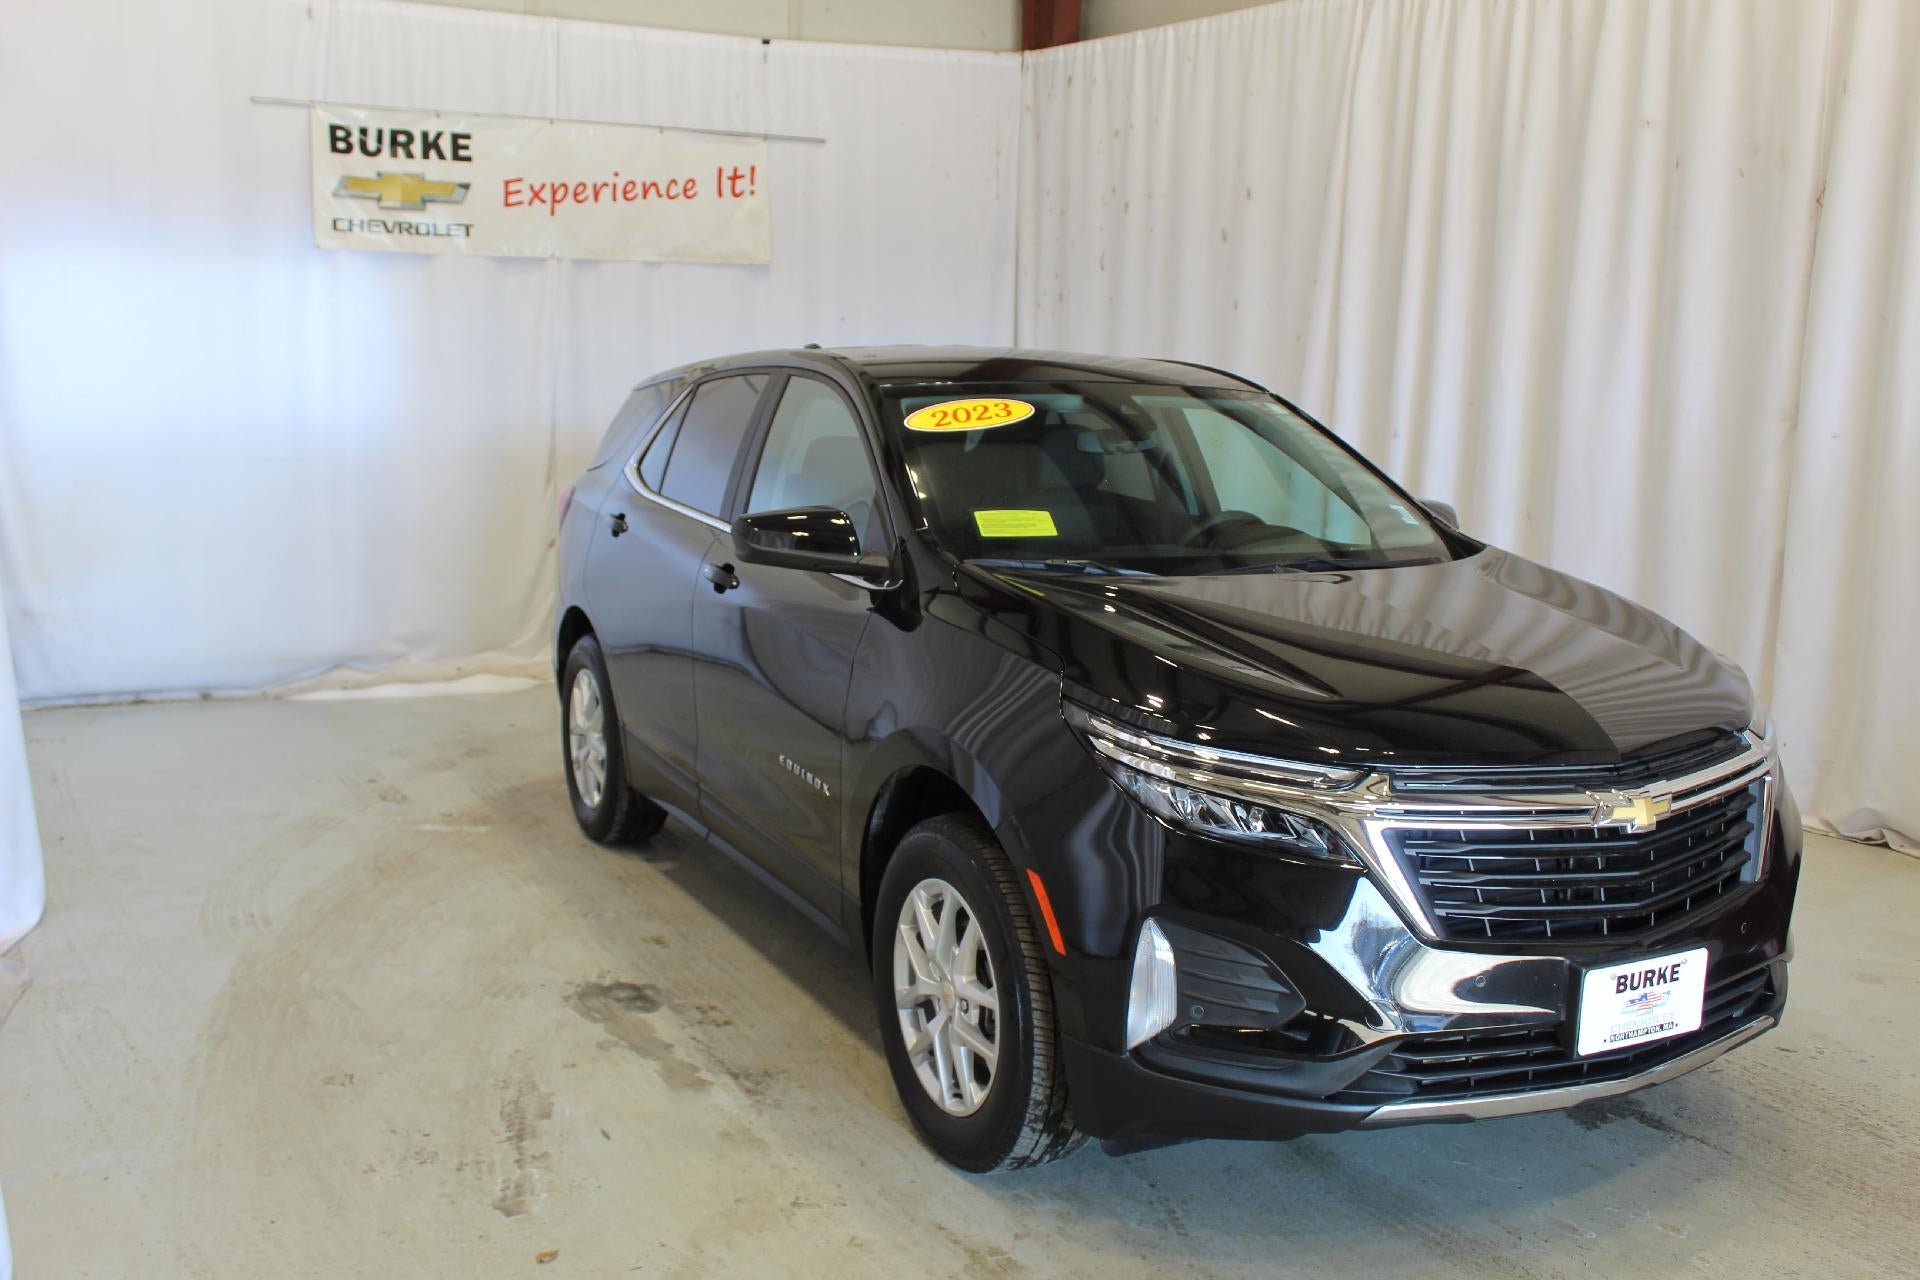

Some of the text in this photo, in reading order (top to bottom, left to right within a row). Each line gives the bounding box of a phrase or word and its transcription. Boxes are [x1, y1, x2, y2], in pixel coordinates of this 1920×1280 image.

[328, 123, 473, 162] BURKE
[503, 165, 757, 216] Experience It!
[332, 217, 474, 238] CHEVROLET
[931, 402, 1013, 428] 2023
[779, 753, 830, 797] EQUINOX
[1615, 963, 1681, 994] BURKE
